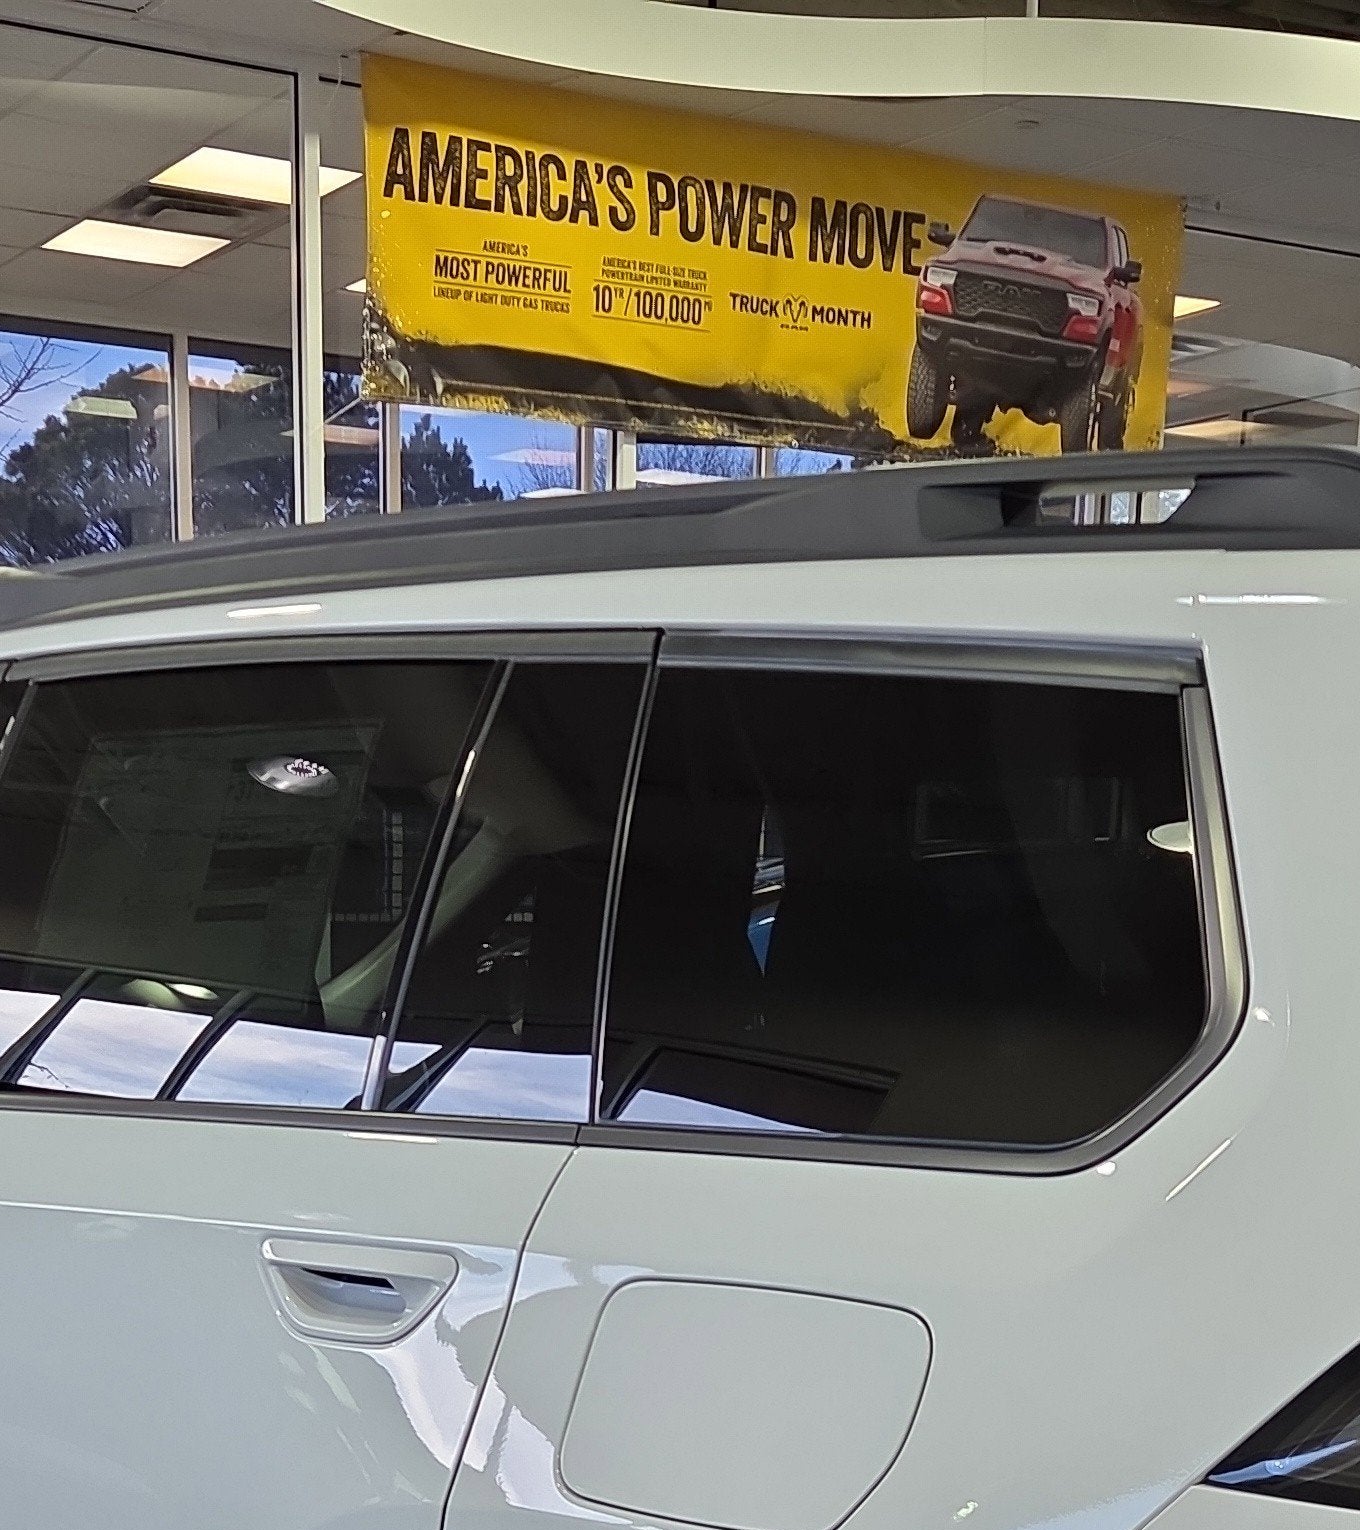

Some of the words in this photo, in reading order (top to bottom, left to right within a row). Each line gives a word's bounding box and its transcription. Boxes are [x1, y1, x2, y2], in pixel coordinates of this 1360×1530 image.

[383, 127, 636, 231] AMERICA'S
[647, 170, 797, 259] POWER
[808, 196, 926, 276] MOVE
[482, 239, 529, 257] AMERICA'S
[434, 254, 482, 283] MOST
[484, 260, 572, 294] POWERFUL
[463, 290, 474, 301] OF
[475, 291, 499, 305] LIGHT
[500, 294, 521, 309] DUTY
[522, 297, 539, 310] GAS
[541, 299, 571, 314] TRUCKS
[729, 291, 780, 318] TRUCK
[811, 304, 872, 330] MONTH
